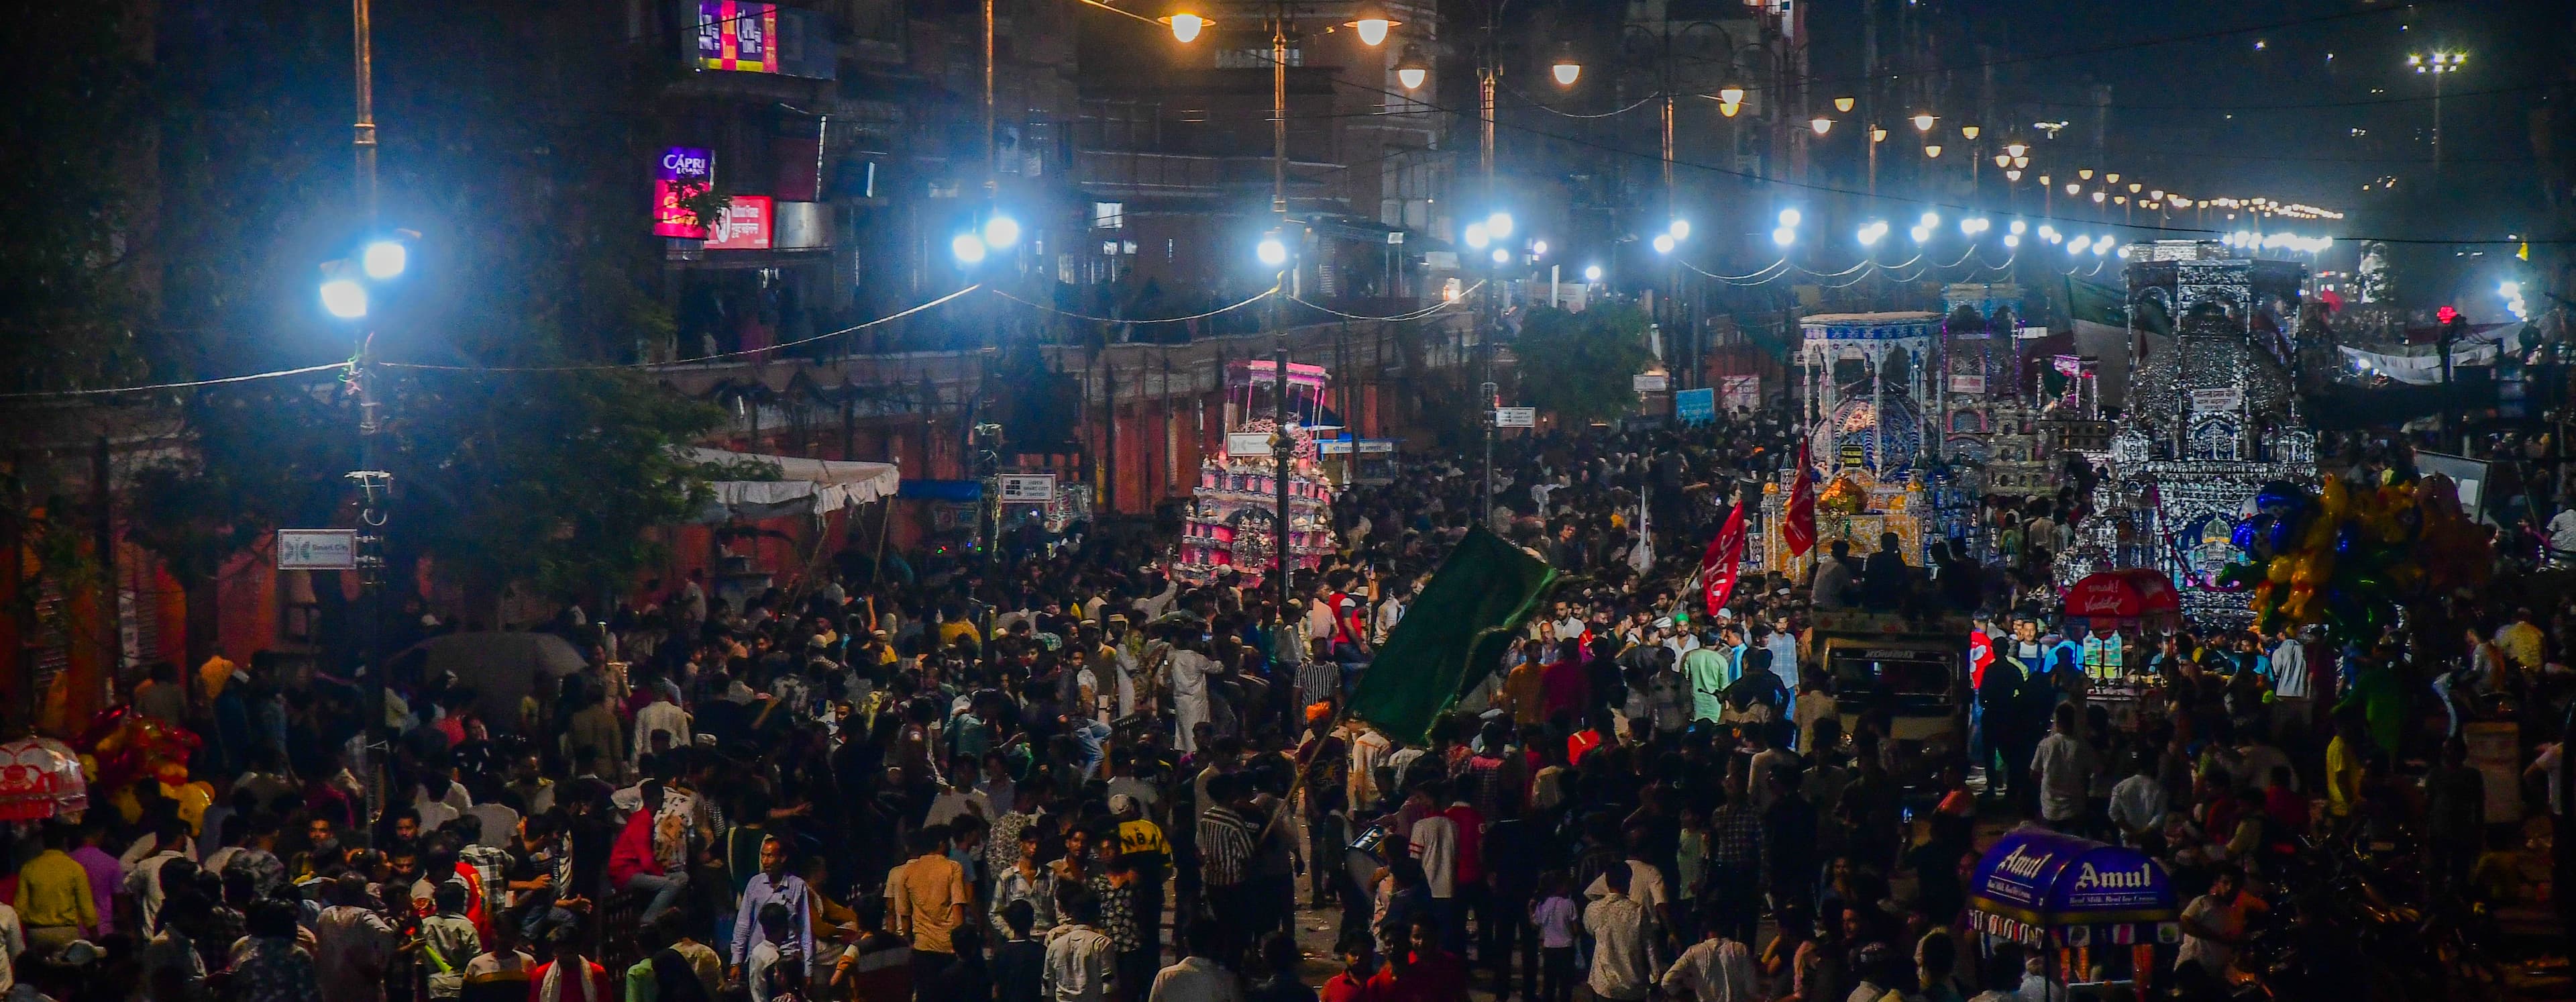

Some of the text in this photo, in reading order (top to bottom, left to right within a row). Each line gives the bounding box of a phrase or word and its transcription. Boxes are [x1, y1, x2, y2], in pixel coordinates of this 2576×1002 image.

[1122, 832, 1159, 850] NBA
[1995, 844, 2053, 879] Amul
[2074, 861, 2151, 892] Amul
